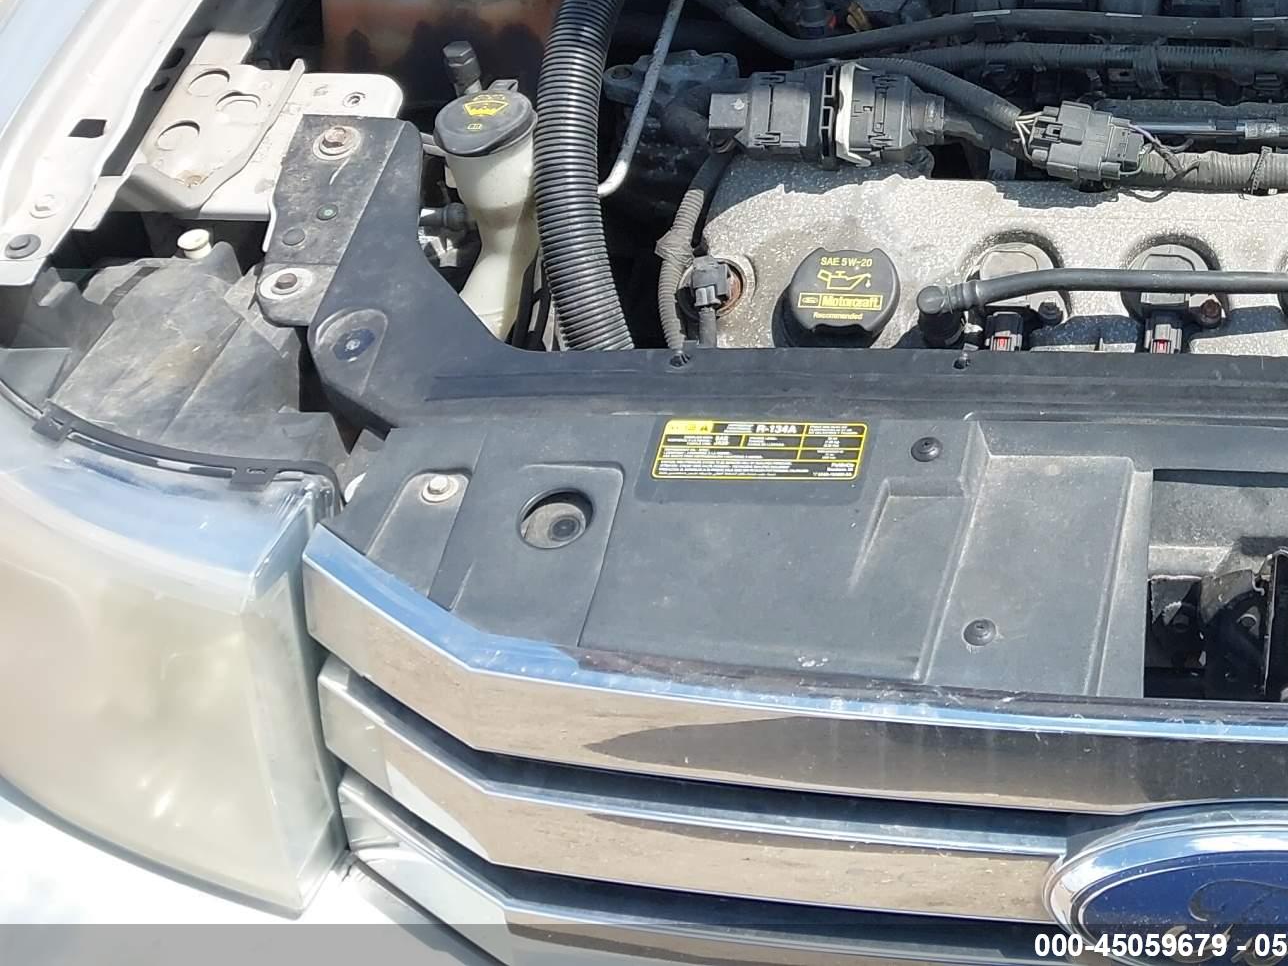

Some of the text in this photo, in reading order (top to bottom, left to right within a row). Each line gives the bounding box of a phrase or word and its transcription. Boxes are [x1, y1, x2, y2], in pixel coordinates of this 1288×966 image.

[820, 257, 873, 267] SAE 5W-20
[821, 295, 880, 308] Motorcraft
[755, 424, 797, 434] R-134A
